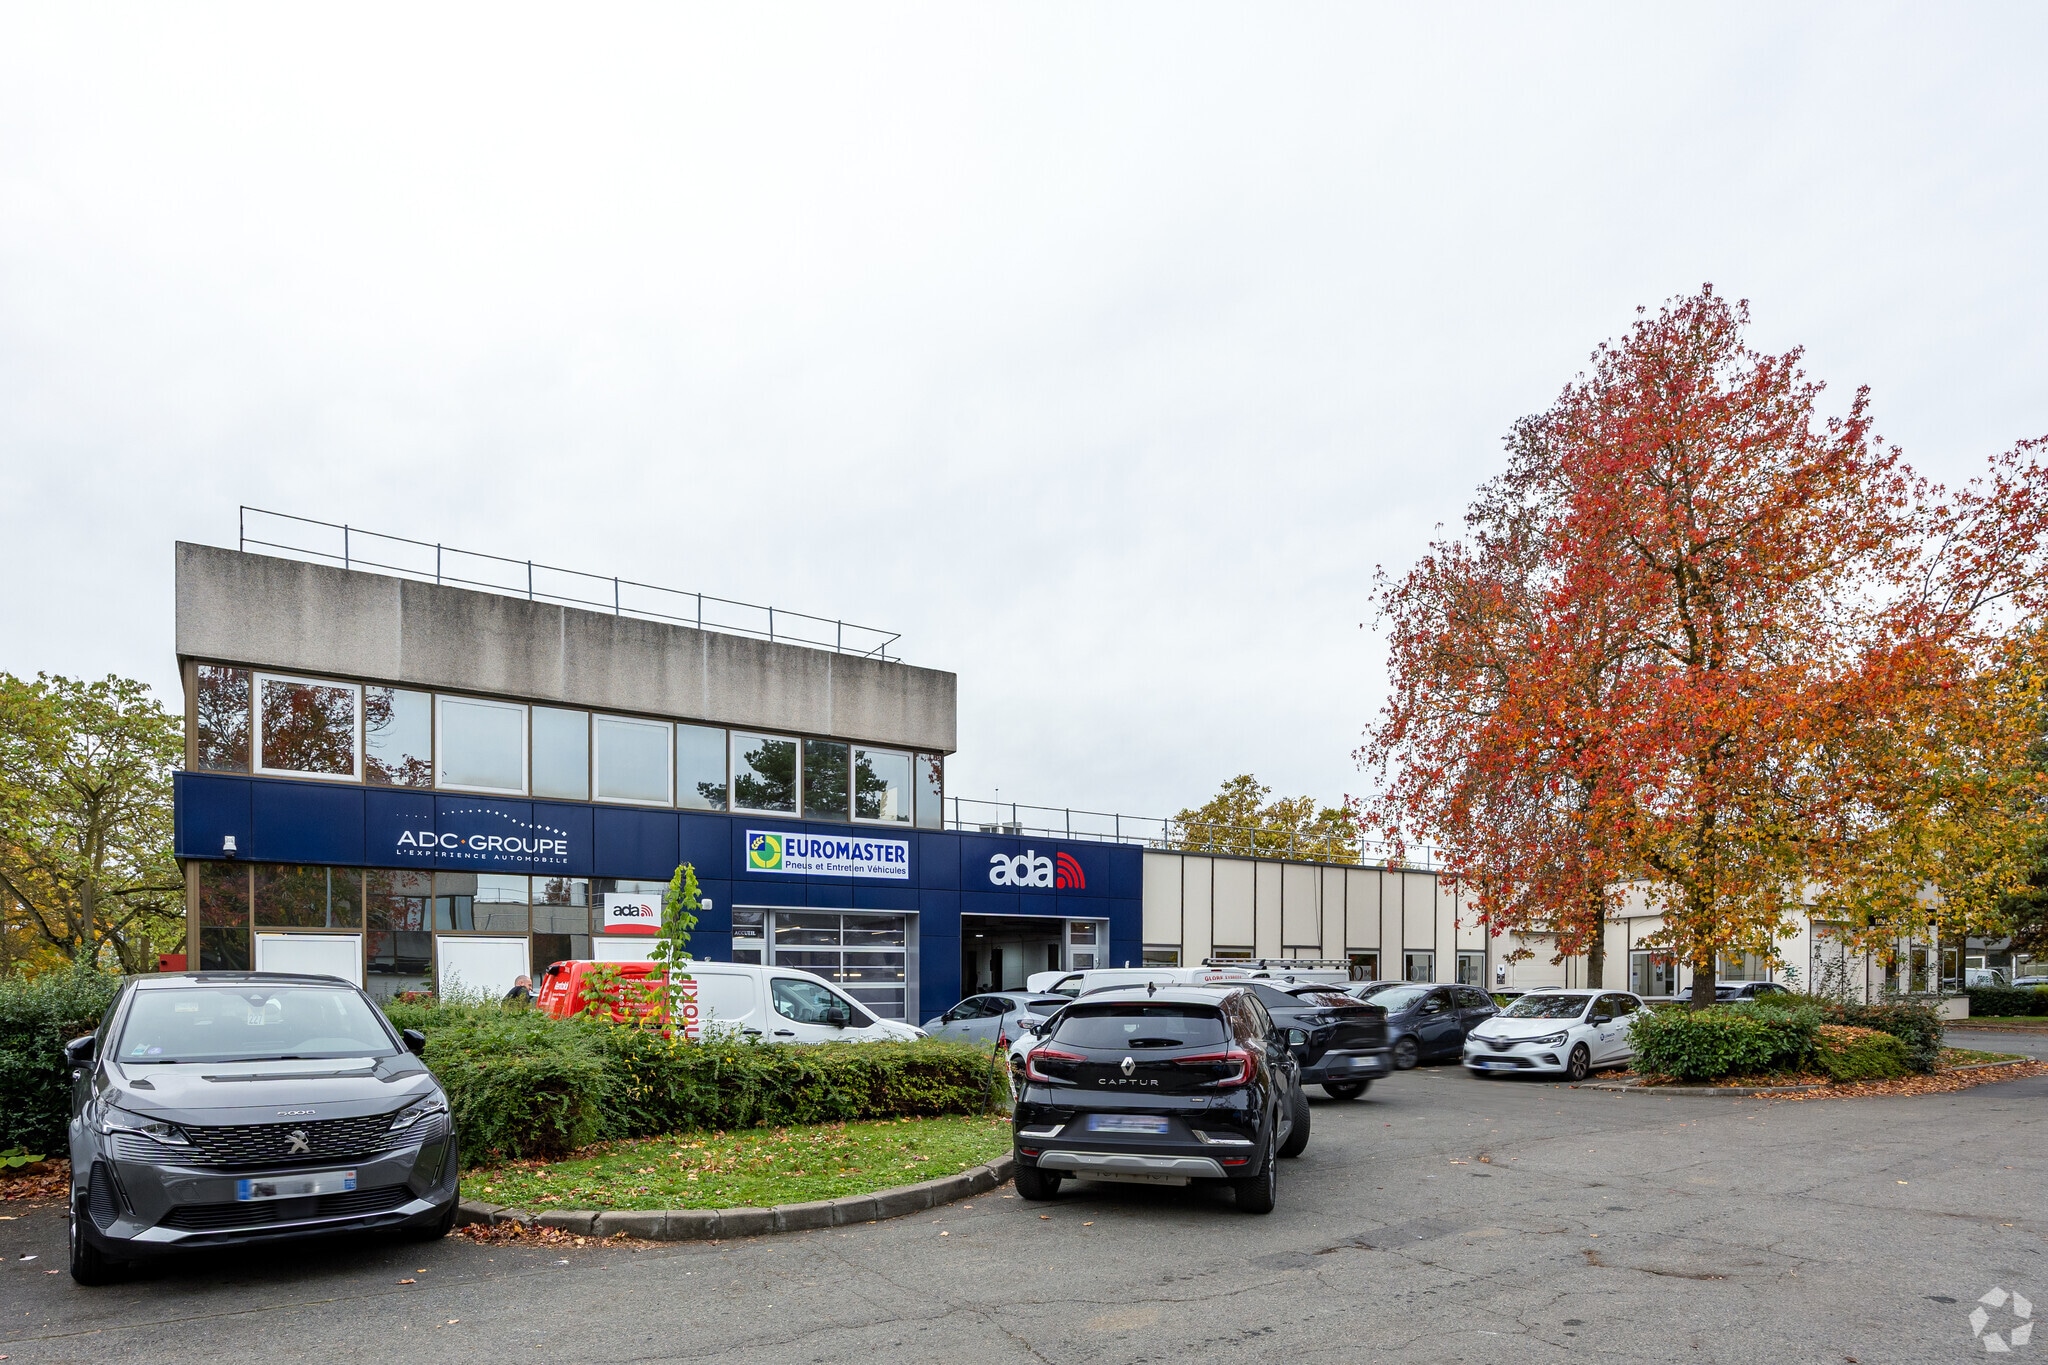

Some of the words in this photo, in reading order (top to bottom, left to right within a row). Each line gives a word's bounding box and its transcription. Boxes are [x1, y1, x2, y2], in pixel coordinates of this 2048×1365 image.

[396, 830, 459, 849] ADC
[468, 834, 568, 855] GROUPE
[785, 838, 906, 864] EUROMASTER
[493, 855, 568, 864] AUTOMOBILE
[785, 860, 813, 870] Pneus
[815, 862, 824, 871] et
[826, 863, 865, 873] Entreten
[867, 865, 907, 875] Véhicules
[989, 849, 1054, 888] ada
[613, 903, 640, 917] ada
[678, 979, 700, 1040] ntokil
[1098, 1078, 1159, 1087] CAPTUR
